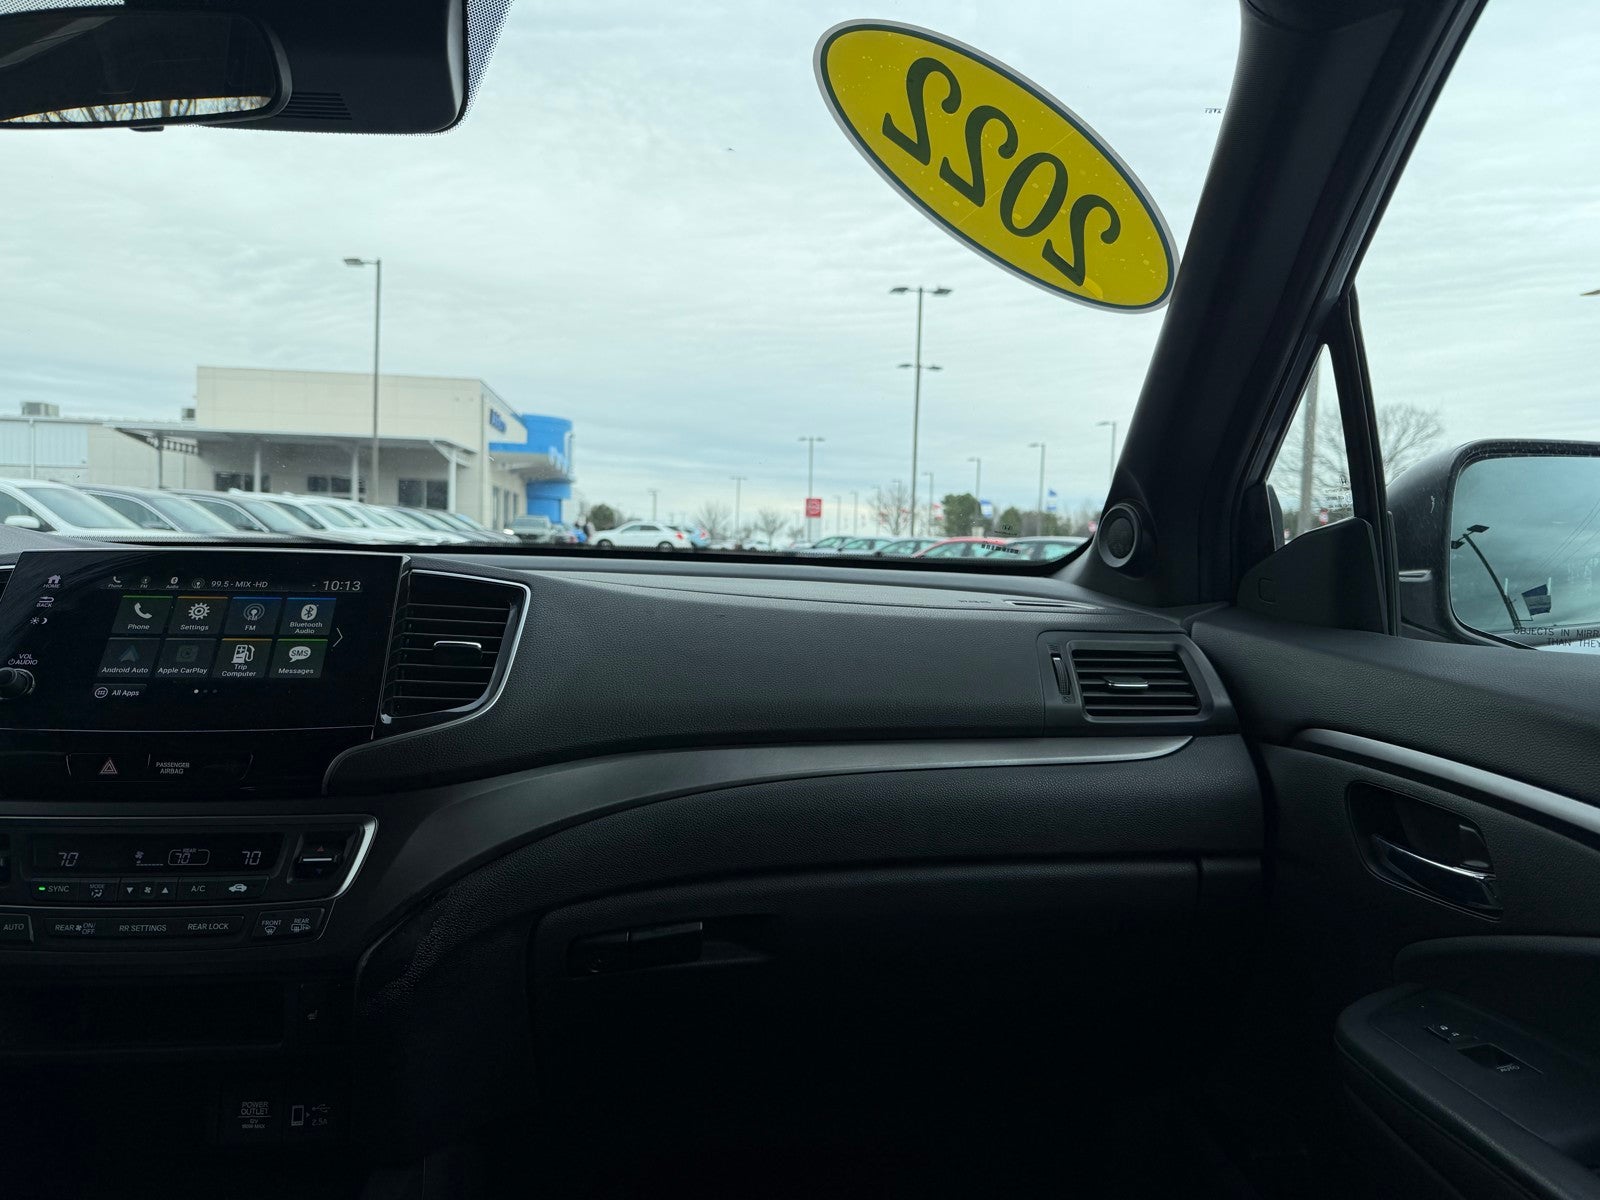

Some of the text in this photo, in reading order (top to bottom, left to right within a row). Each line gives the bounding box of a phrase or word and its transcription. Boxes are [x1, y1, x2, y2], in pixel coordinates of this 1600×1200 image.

[211, 580, 230, 589] 99.5
[235, 580, 252, 589] MIX
[323, 580, 362, 592] 10:13
[127, 623, 150, 631] Phone
[180, 623, 209, 632] Settings
[244, 624, 256, 632] FM
[289, 621, 323, 629] Bluetooth
[1514, 627, 1554, 636] OBJECTS
[1560, 629, 1570, 637] IN
[1547, 638, 1572, 646] THAN
[19, 652, 33, 660] VOL
[290, 649, 310, 657] SMS
[102, 666, 149, 675] Android Auto
[158, 666, 208, 676] Apple CarPlay
[233, 663, 248, 671] Trip
[278, 667, 314, 676] Messages
[221, 670, 257, 678] Computer
[111, 688, 140, 699] All Apps
[155, 761, 191, 769] PASSENGER
[58, 851, 79, 867] 70
[175, 851, 191, 865] 70
[240, 850, 262, 866] 70
[47, 884, 70, 893] SYNC
[190, 884, 206, 893] A/C
[261, 919, 282, 927] FRONT
[293, 917, 310, 925] REAR
[2, 923, 25, 932] AUTO
[54, 923, 76, 932] REAR
[119, 924, 167, 933] RR SETTINGS
[187, 921, 230, 931] REAR LOCK
[81, 928, 96, 936] OFF
[240, 1107, 268, 1116] OUTLET
